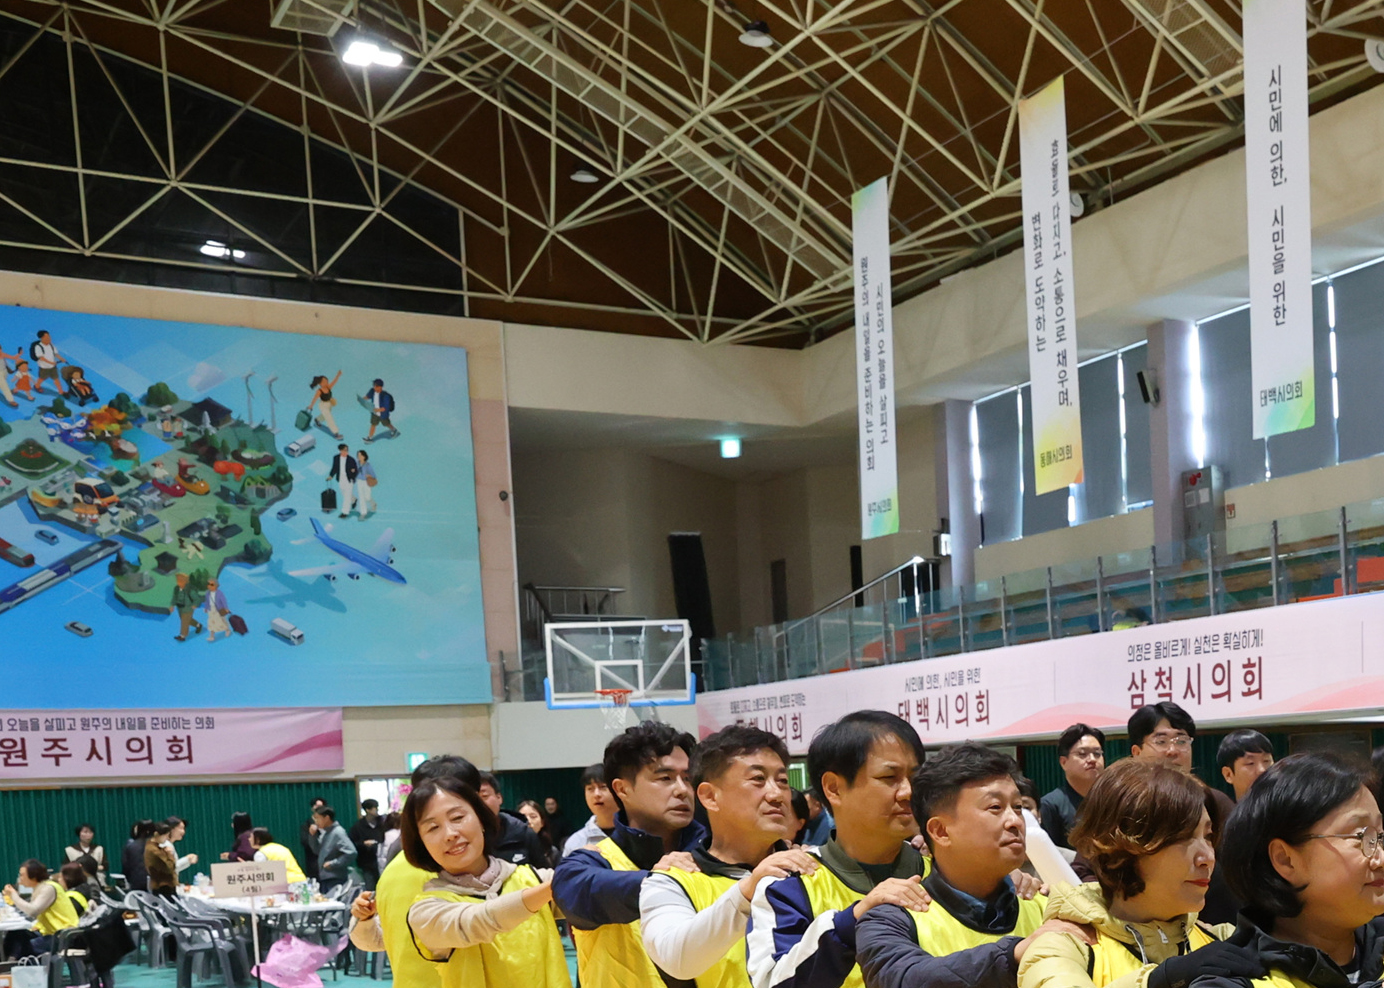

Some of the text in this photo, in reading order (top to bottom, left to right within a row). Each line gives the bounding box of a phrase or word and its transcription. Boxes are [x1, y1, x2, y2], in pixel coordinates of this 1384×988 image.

[1268, 64, 1287, 326] 시민에 의한, 시민을 위한
[1032, 211, 1047, 352] 변화로 도약하는
[1053, 267, 1067, 343] 소통으로
[1056, 348, 1073, 407] 채우며,
[1259, 380, 1303, 408] 태백시의회
[1039, 444, 1073, 468] 동해시의회
[1127, 628, 1263, 664] 의정은 올바르게! 실천은 확실하게!
[904, 676, 924, 693] 시민에
[944, 670, 964, 687] 시민을
[967, 667, 981, 684] 위한
[1127, 656, 1264, 710] 삼척시의회
[7, 717, 40, 731] 오늘을
[44, 717, 77, 731] 살피고
[80, 717, 113, 731] 원주의
[116, 716, 147, 731] 내일을
[151, 716, 191, 730] 준비하는
[194, 715, 215, 730] 의회
[898, 688, 990, 732] 태백시의회
[0, 735, 194, 767] 원주시의회
[226, 872, 275, 885] 원주시의회
